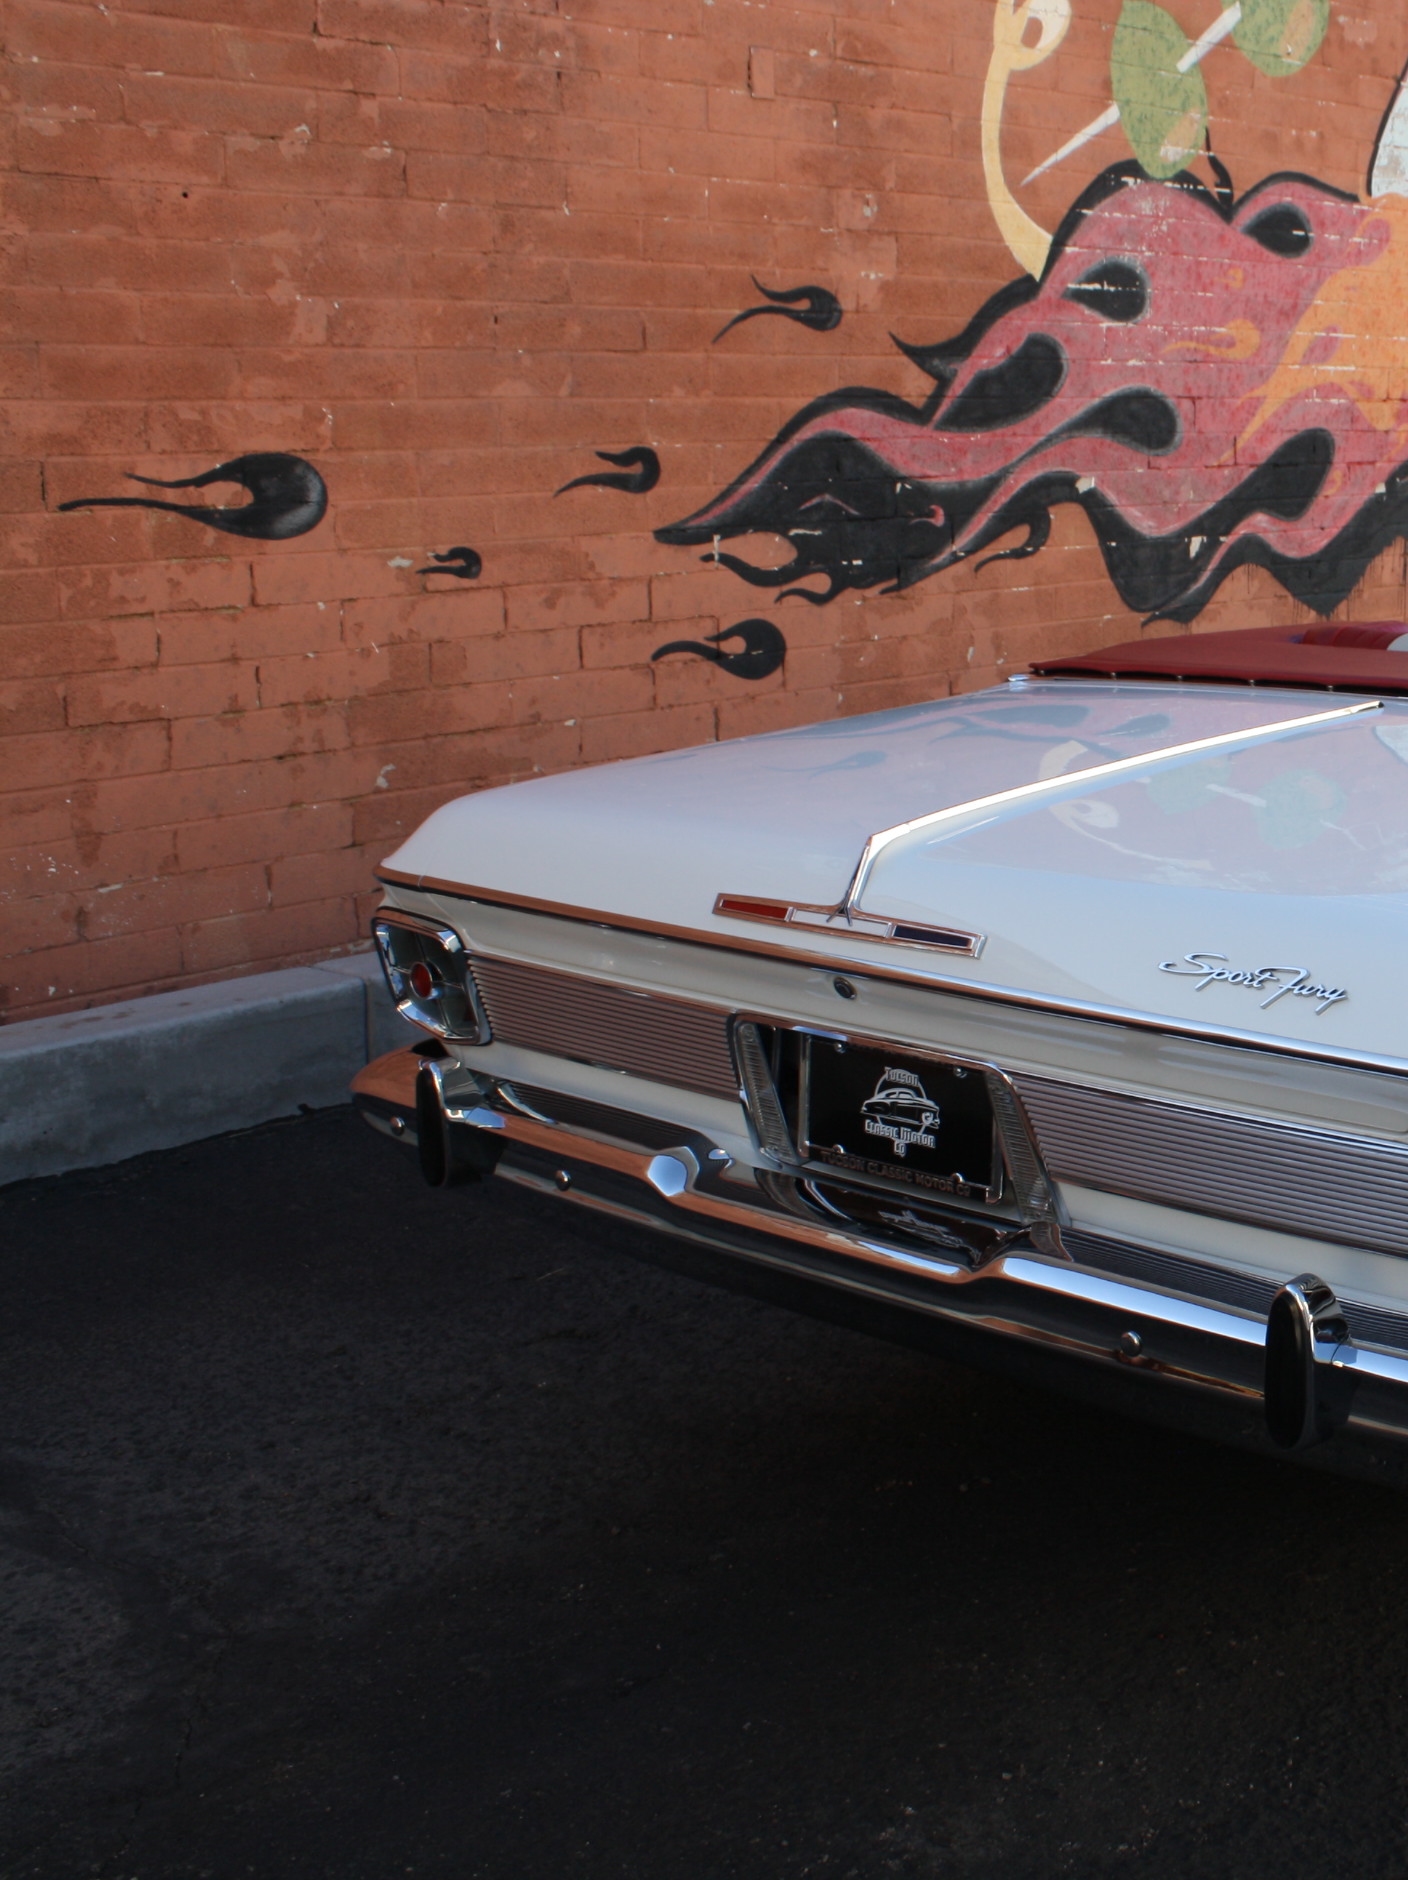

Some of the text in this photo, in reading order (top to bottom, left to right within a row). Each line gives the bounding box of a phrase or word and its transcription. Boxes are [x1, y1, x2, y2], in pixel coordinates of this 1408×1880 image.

[1158, 952, 1349, 1016] Sport Fury
[820, 1151, 864, 1171] TUCSON
[867, 1161, 913, 1183] CLASSIC
[915, 1173, 954, 1193] MOTOR
